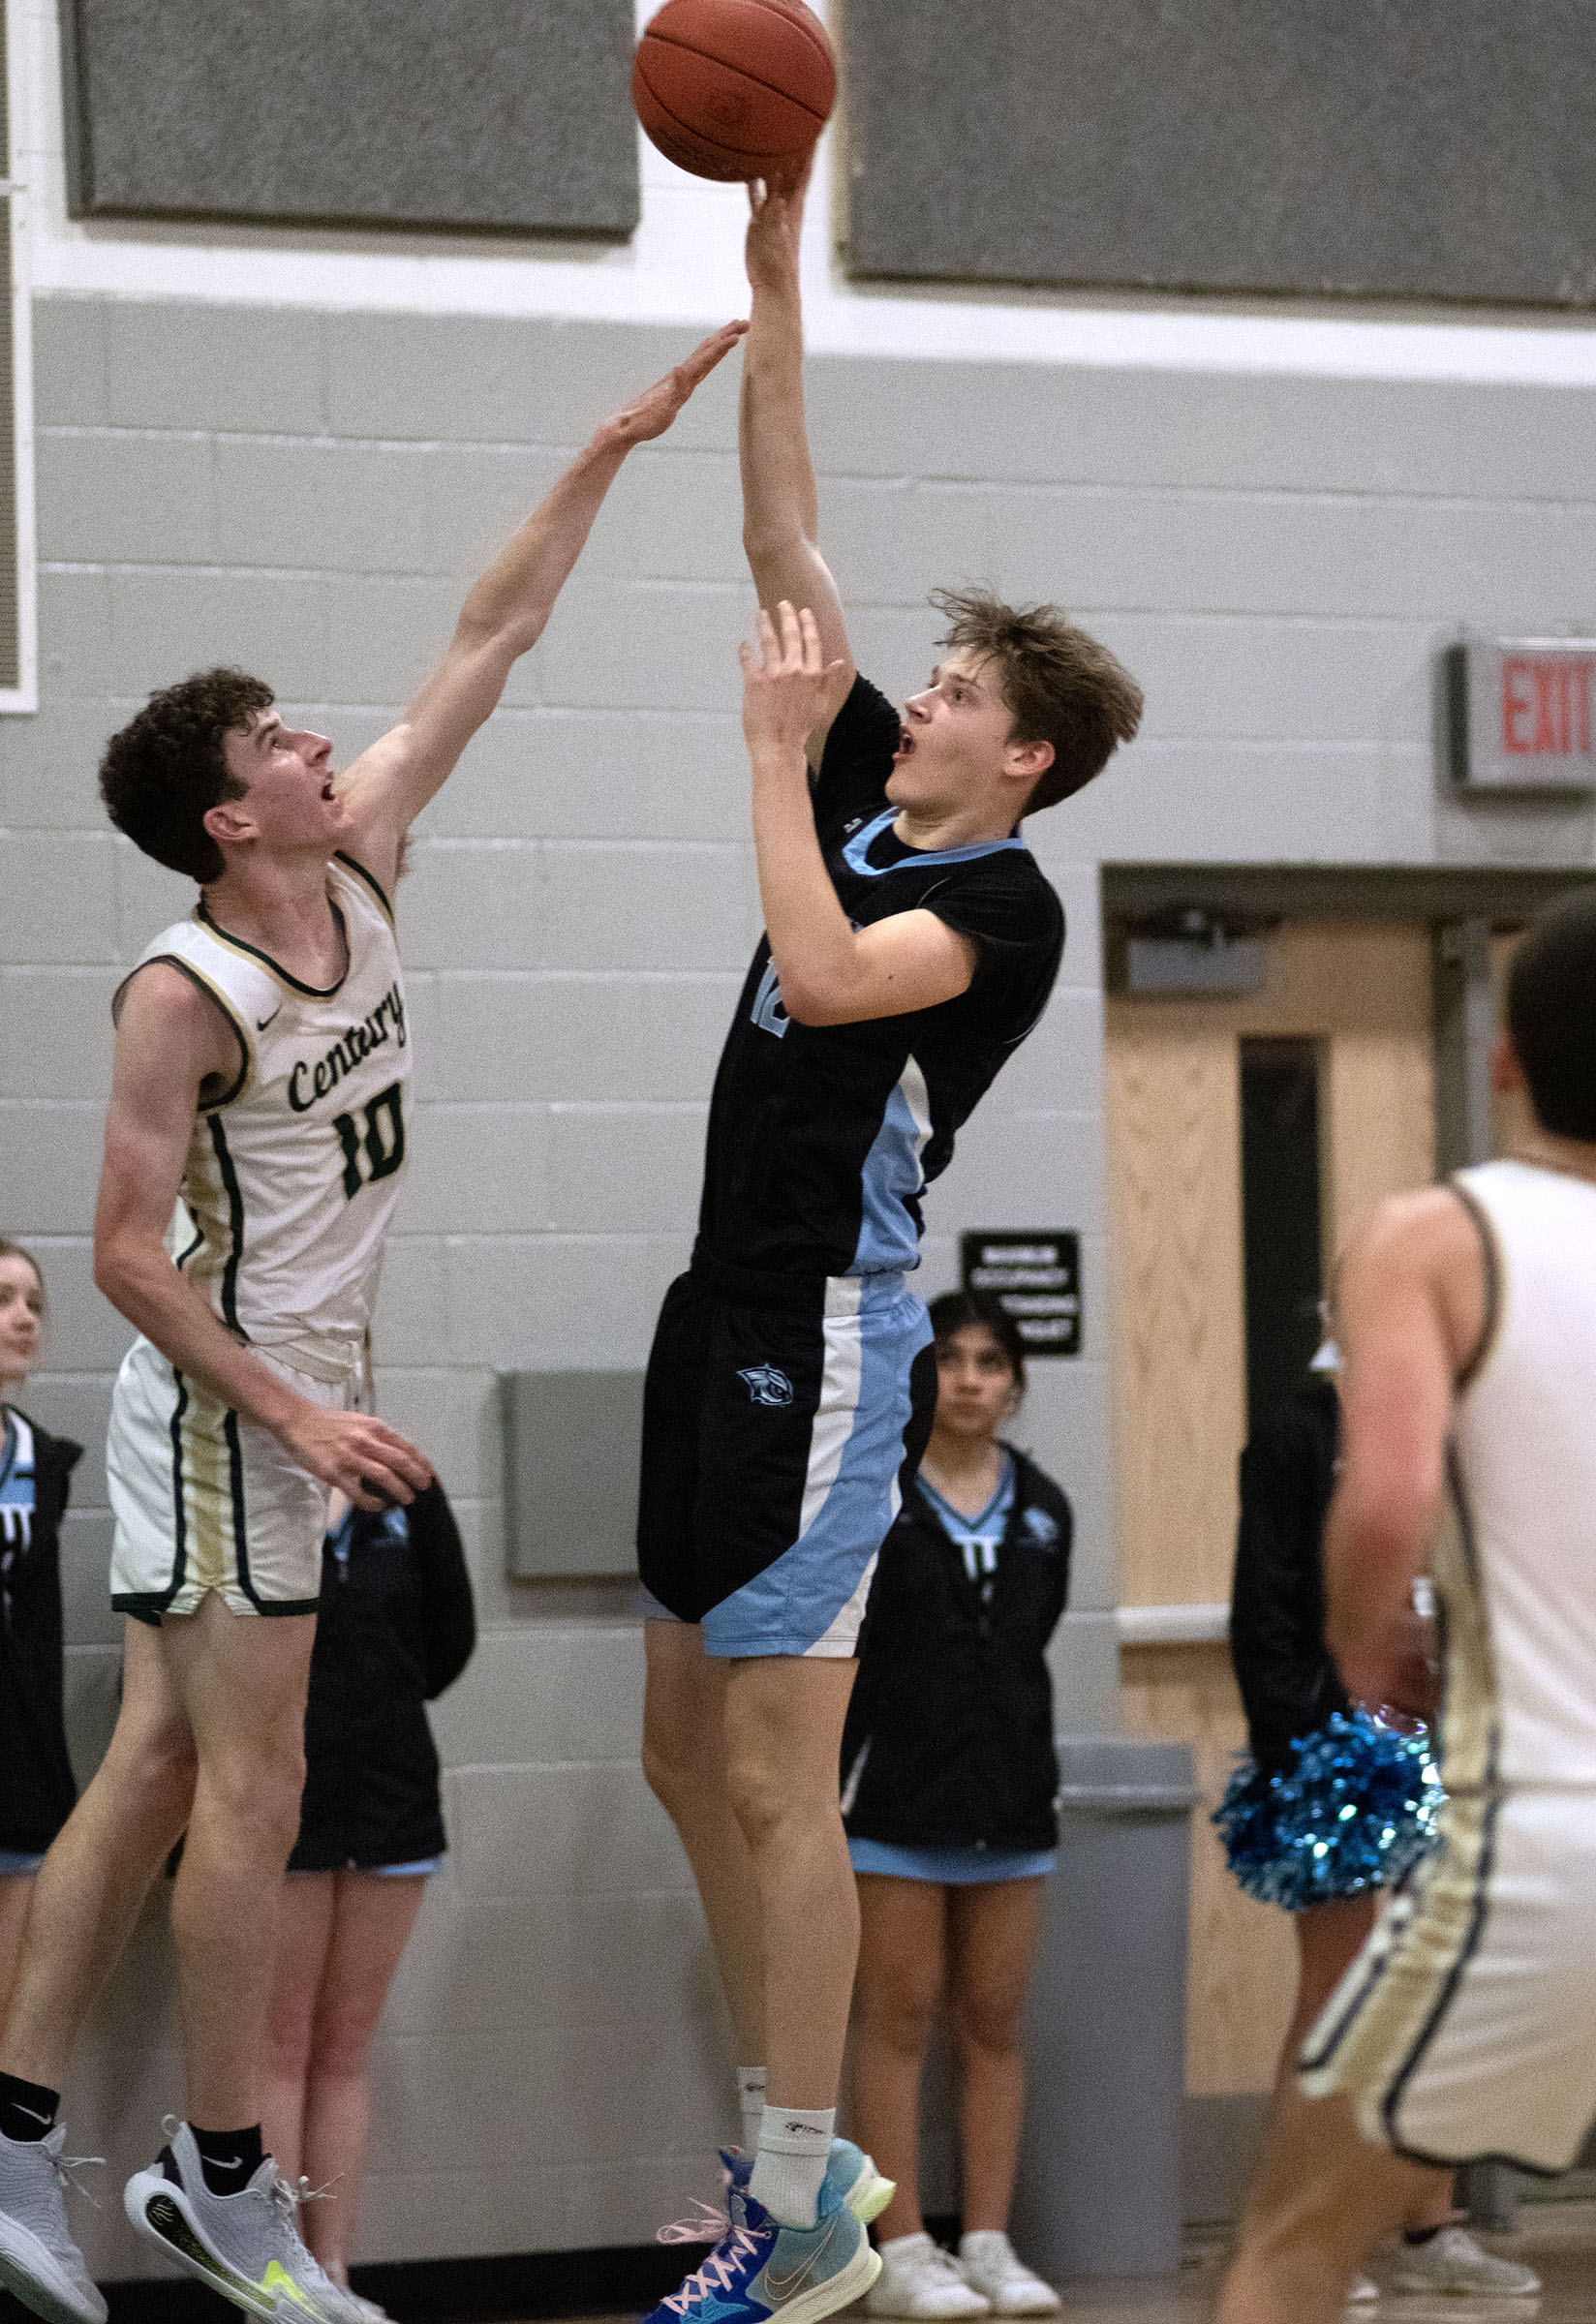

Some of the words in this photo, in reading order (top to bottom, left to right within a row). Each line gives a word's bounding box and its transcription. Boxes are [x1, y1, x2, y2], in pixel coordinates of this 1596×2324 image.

[1502, 658, 1592, 754] EXIT
[289, 981, 406, 1112] Century
[332, 1081, 405, 1201] 10
